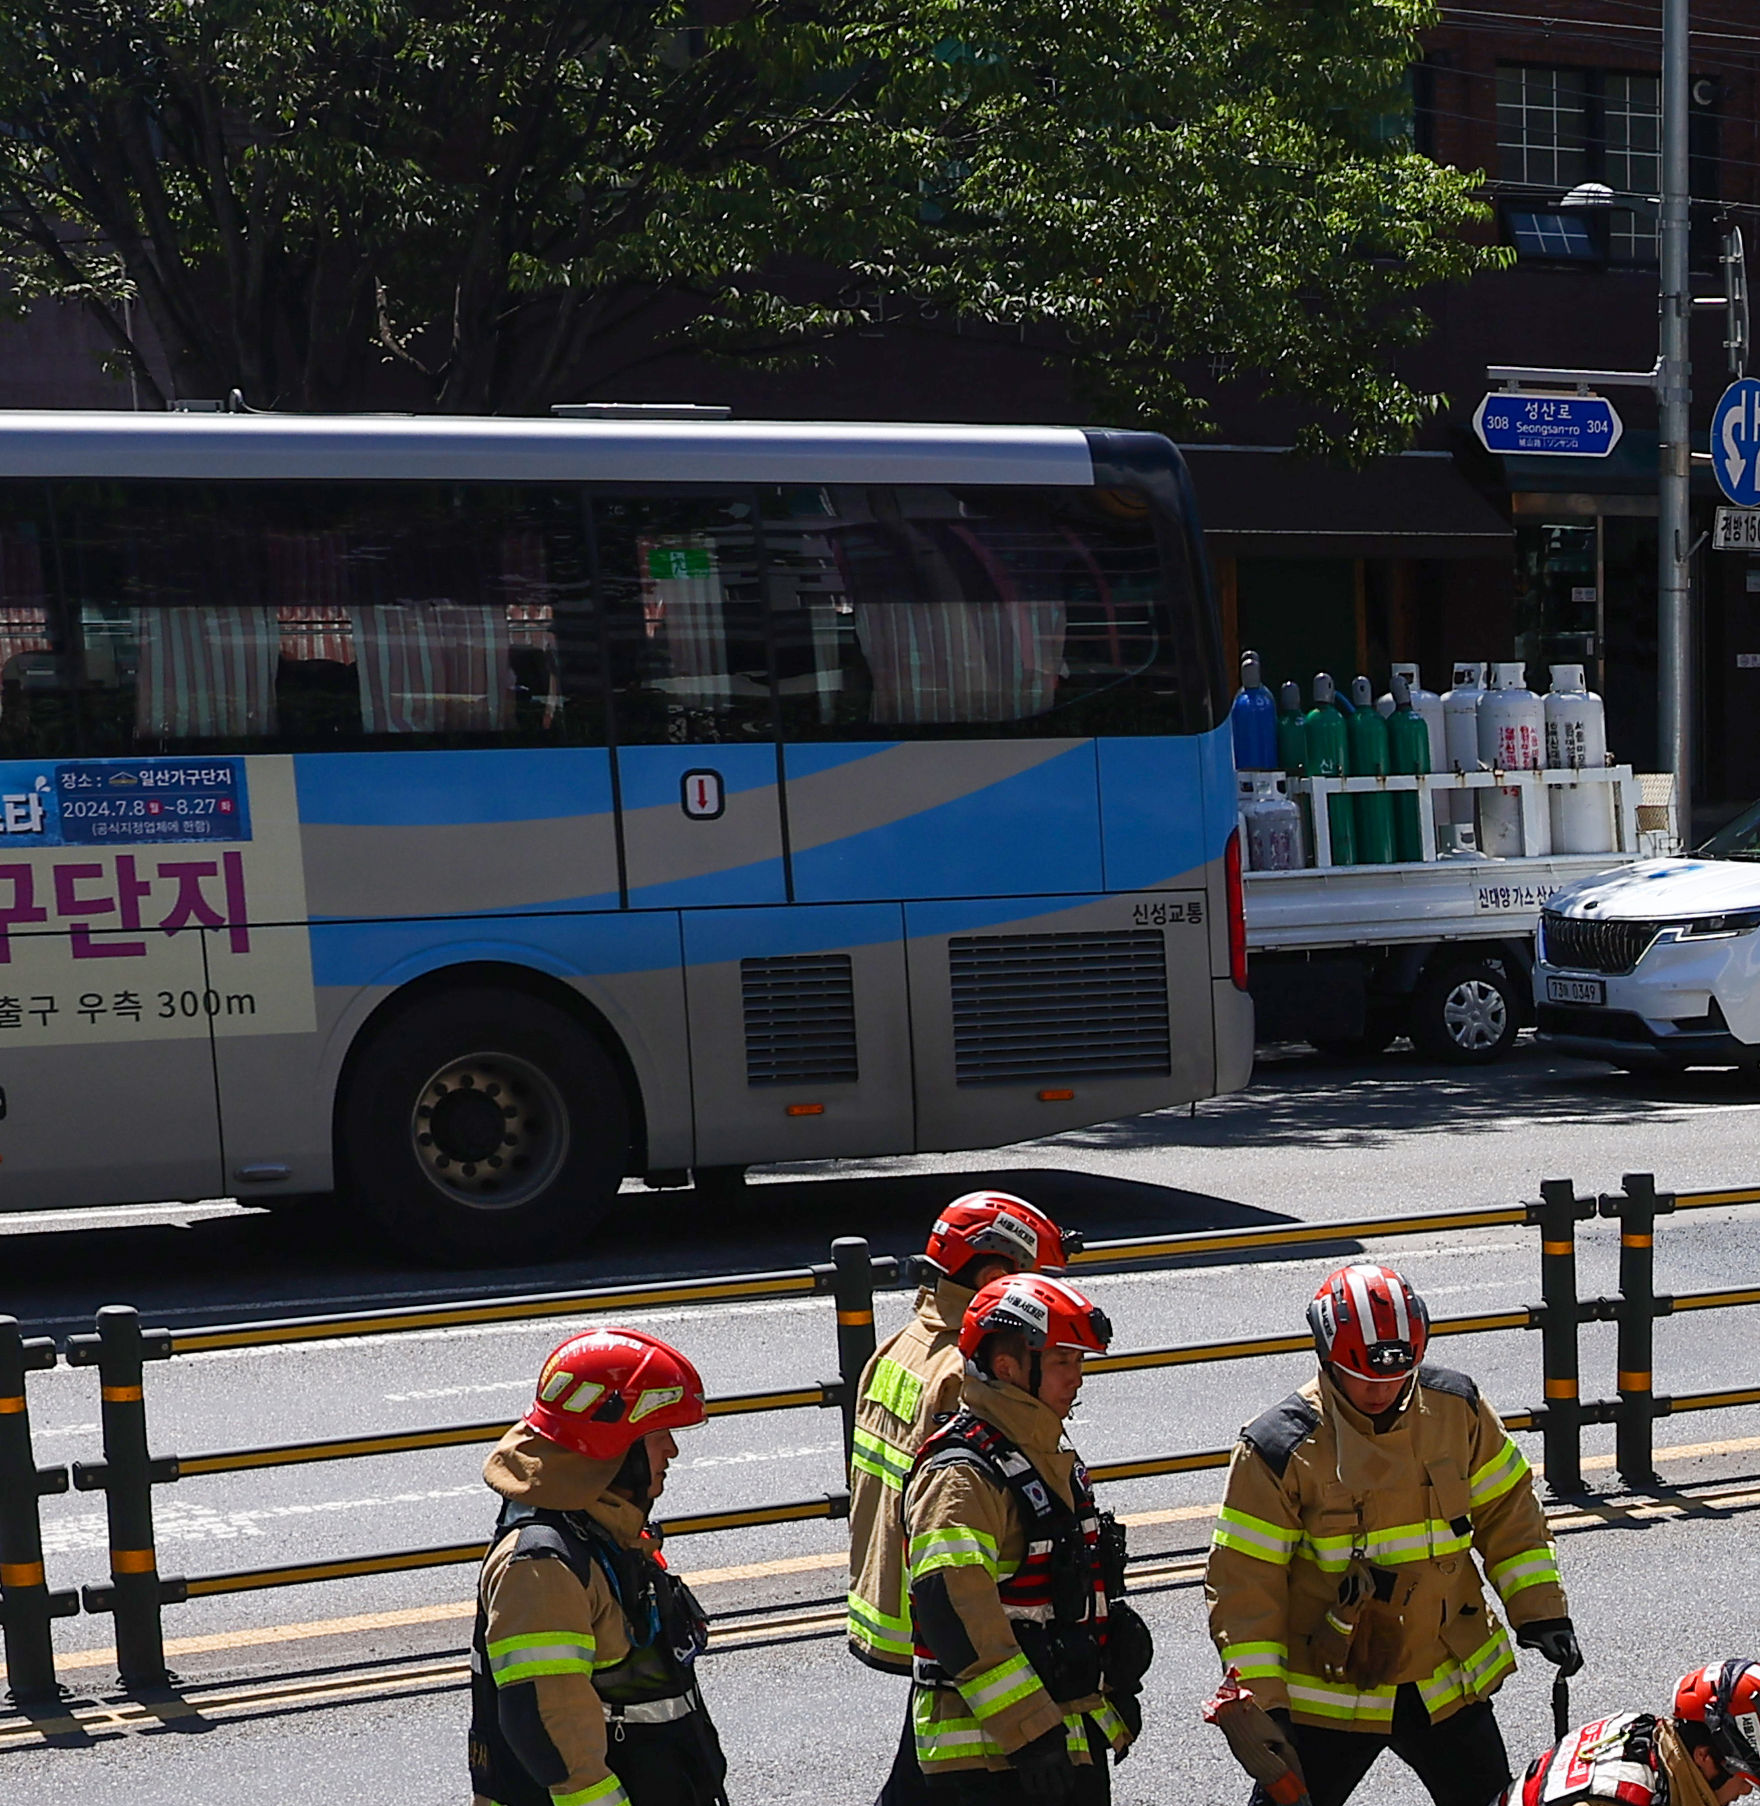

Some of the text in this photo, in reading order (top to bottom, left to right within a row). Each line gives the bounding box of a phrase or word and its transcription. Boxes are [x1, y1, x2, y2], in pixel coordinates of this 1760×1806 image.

[1524, 402, 1572, 421] 성산로
[1487, 416, 1510, 430] 308
[1516, 421, 1581, 436] Seongsan-ro
[1587, 420, 1608, 434] 304
[61, 772, 93, 789] 장소
[139, 768, 232, 787] 일산가구단지
[0, 793, 44, 833] 타
[1479, 886, 1511, 909] 신대양
[1512, 886, 1535, 907] 가스
[1132, 902, 1204, 926] 신성교통
[1572, 983, 1596, 1001] 0349
[77, 990, 144, 1025] 우측
[157, 989, 257, 1019] 300m
